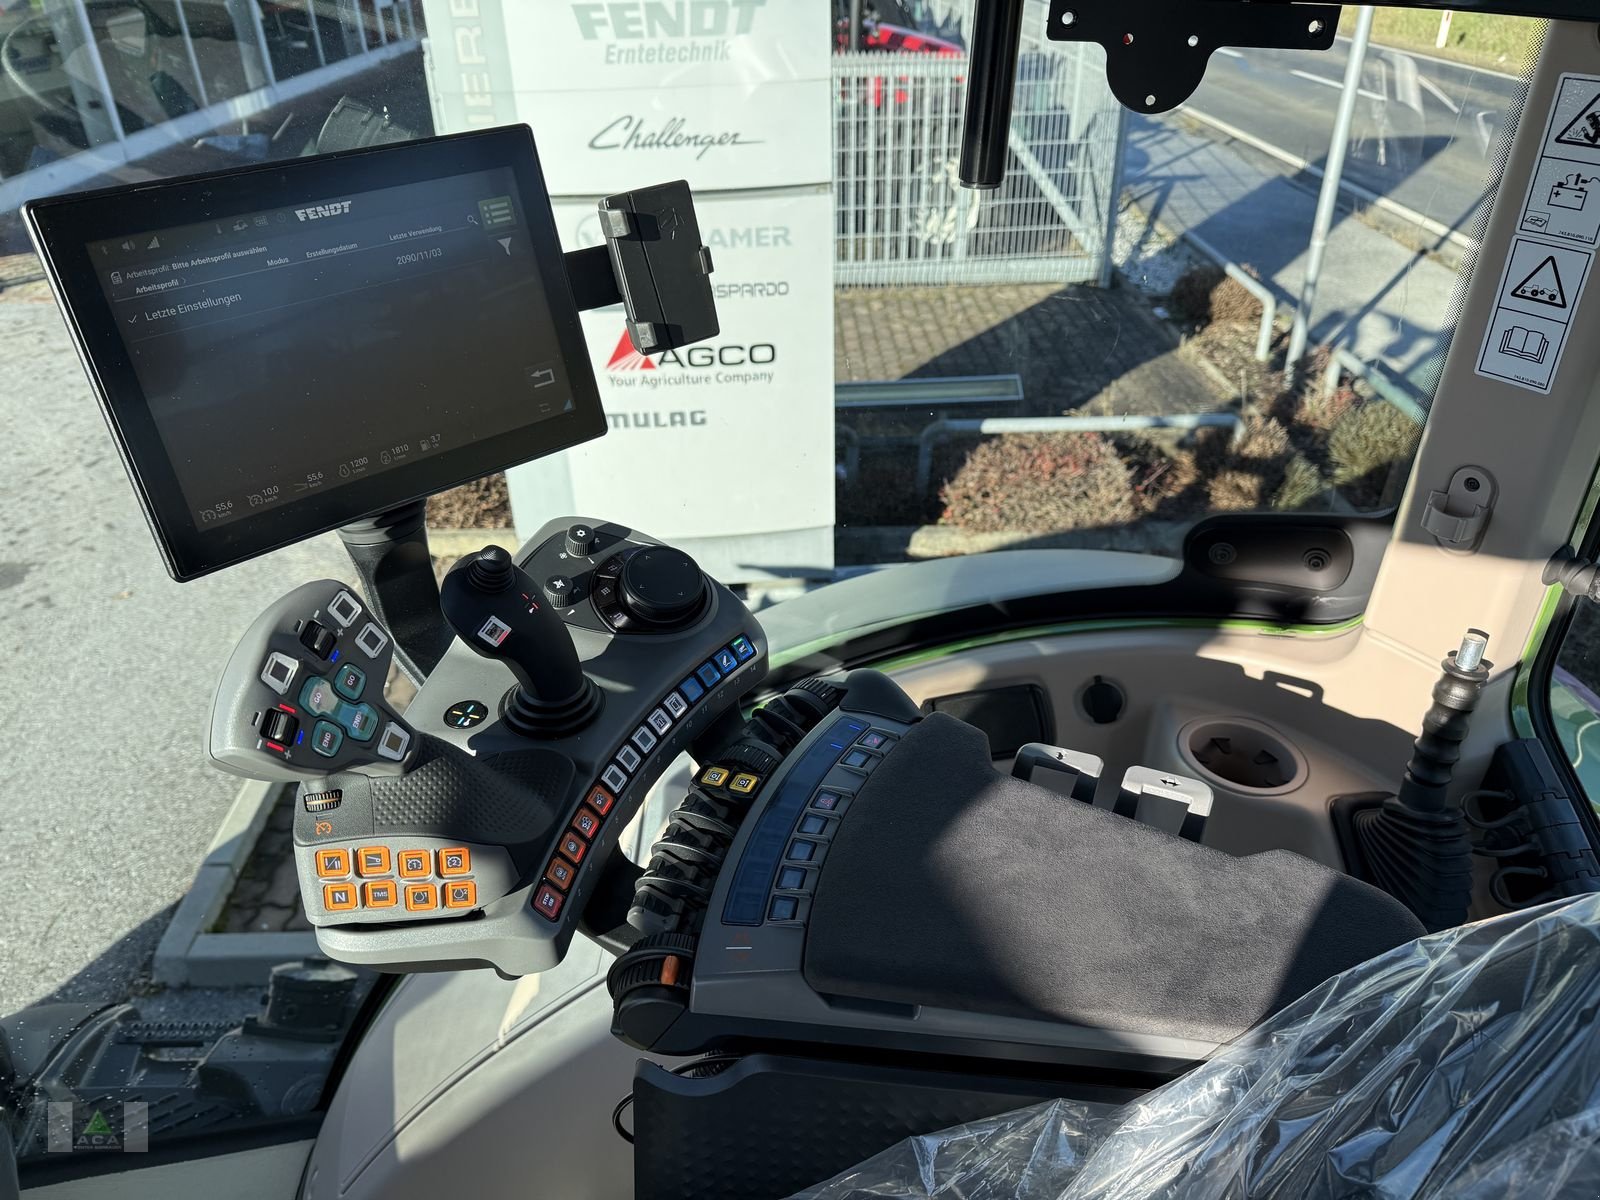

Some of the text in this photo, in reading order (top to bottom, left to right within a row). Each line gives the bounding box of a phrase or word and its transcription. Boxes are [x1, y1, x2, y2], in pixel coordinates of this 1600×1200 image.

[571, 0, 767, 40] FENDT
[604, 39, 731, 65] Erntetechnik
[588, 115, 765, 160] Challenger
[295, 201, 352, 221] FENDT
[389, 225, 442, 241] Letzte Verwendung
[306, 242, 359, 259] Erstellungsdatum
[396, 248, 443, 265] 2090/11/03
[126, 246, 268, 280] Arbeitsprofil: Bitte Arbeitsprofil auswählen
[267, 256, 289, 267] Modus
[136, 279, 179, 294] Arbeitsprofil
[145, 292, 242, 322] Letzte Einstellungen
[658, 343, 776, 368] AGCO
[608, 370, 775, 389] Your Agriculture Company
[391, 443, 410, 456] 1810
[350, 456, 369, 469] 1200
[307, 471, 324, 483] 55,6
[262, 485, 280, 497] 10,0
[215, 500, 233, 513] 55,6
[347, 675, 356, 686] GO
[314, 692, 322, 704] GO
[322, 732, 332, 748] END
[335, 893, 346, 902] N
